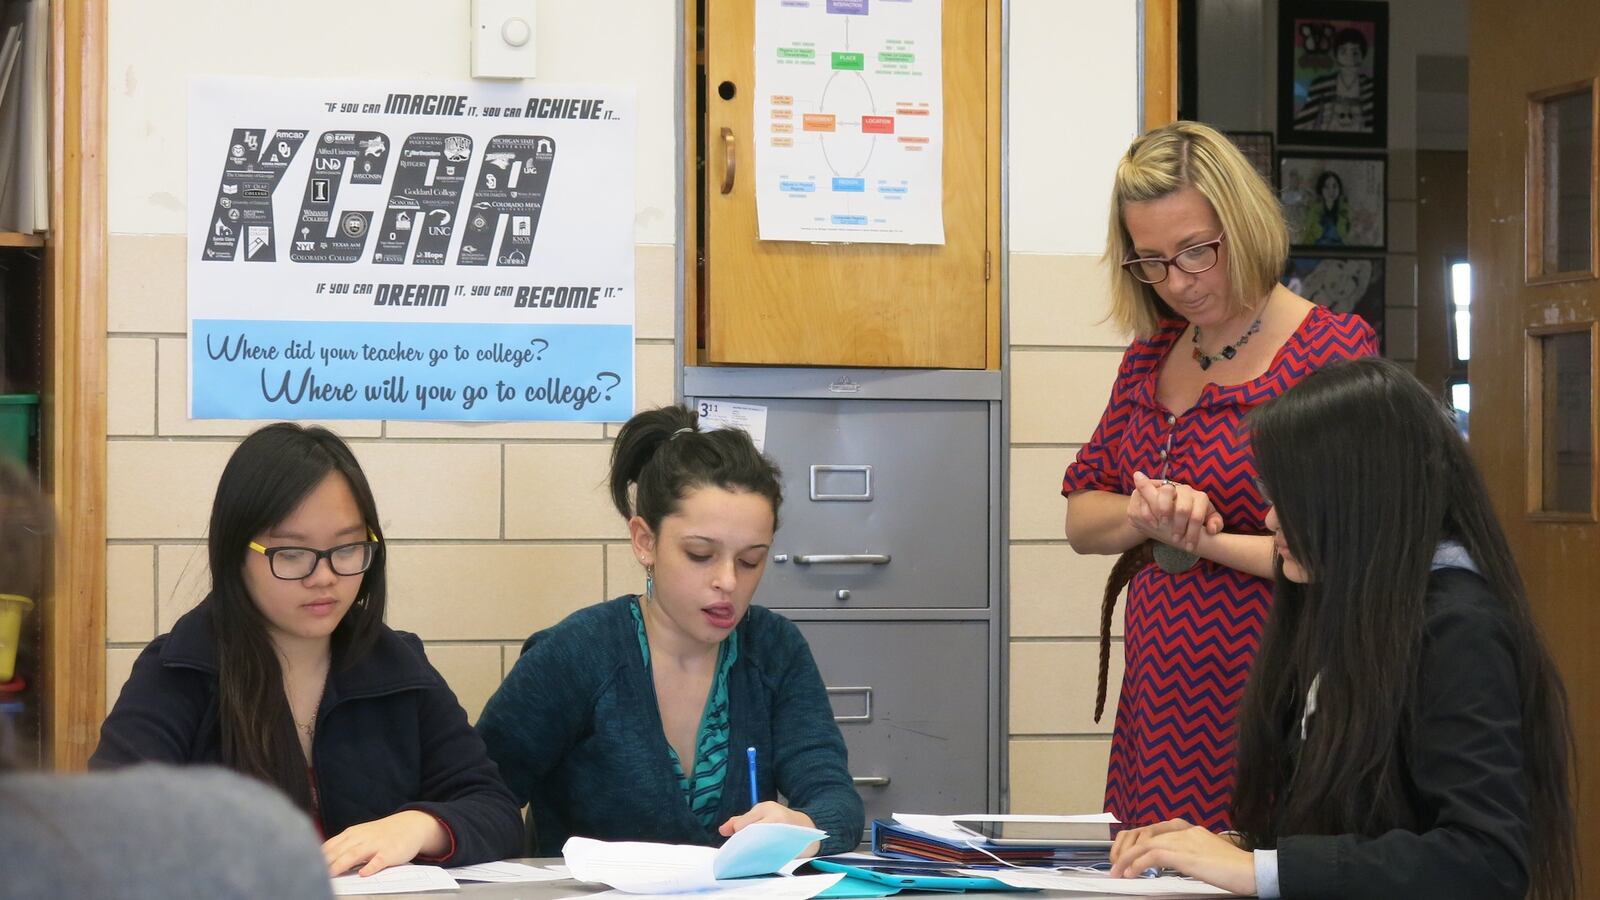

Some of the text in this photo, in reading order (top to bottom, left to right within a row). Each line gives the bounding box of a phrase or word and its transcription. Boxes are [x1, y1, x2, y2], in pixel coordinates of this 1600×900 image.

[340, 103, 359, 113] YOU
[362, 104, 381, 114] CAN
[384, 94, 468, 116] IMAGINE
[467, 106, 478, 117] IT,
[482, 106, 501, 117] YOU
[504, 108, 522, 118] CAN
[524, 98, 604, 120] ACHIEVE
[315, 158, 341, 170] UND
[434, 188, 457, 197] College
[428, 227, 451, 236] UNC
[296, 242, 315, 250] NYU
[316, 283, 326, 294] IF
[329, 283, 350, 294] YOU
[353, 284, 373, 294] CAN
[374, 284, 450, 306] DREAM
[454, 285, 466, 296] IT,
[470, 286, 491, 296] YOU
[494, 286, 514, 296] CAN
[514, 286, 600, 308] BECOME
[207, 333, 549, 368] Where did your teacher go to college?
[261, 367, 621, 411] Where will you go to college?
